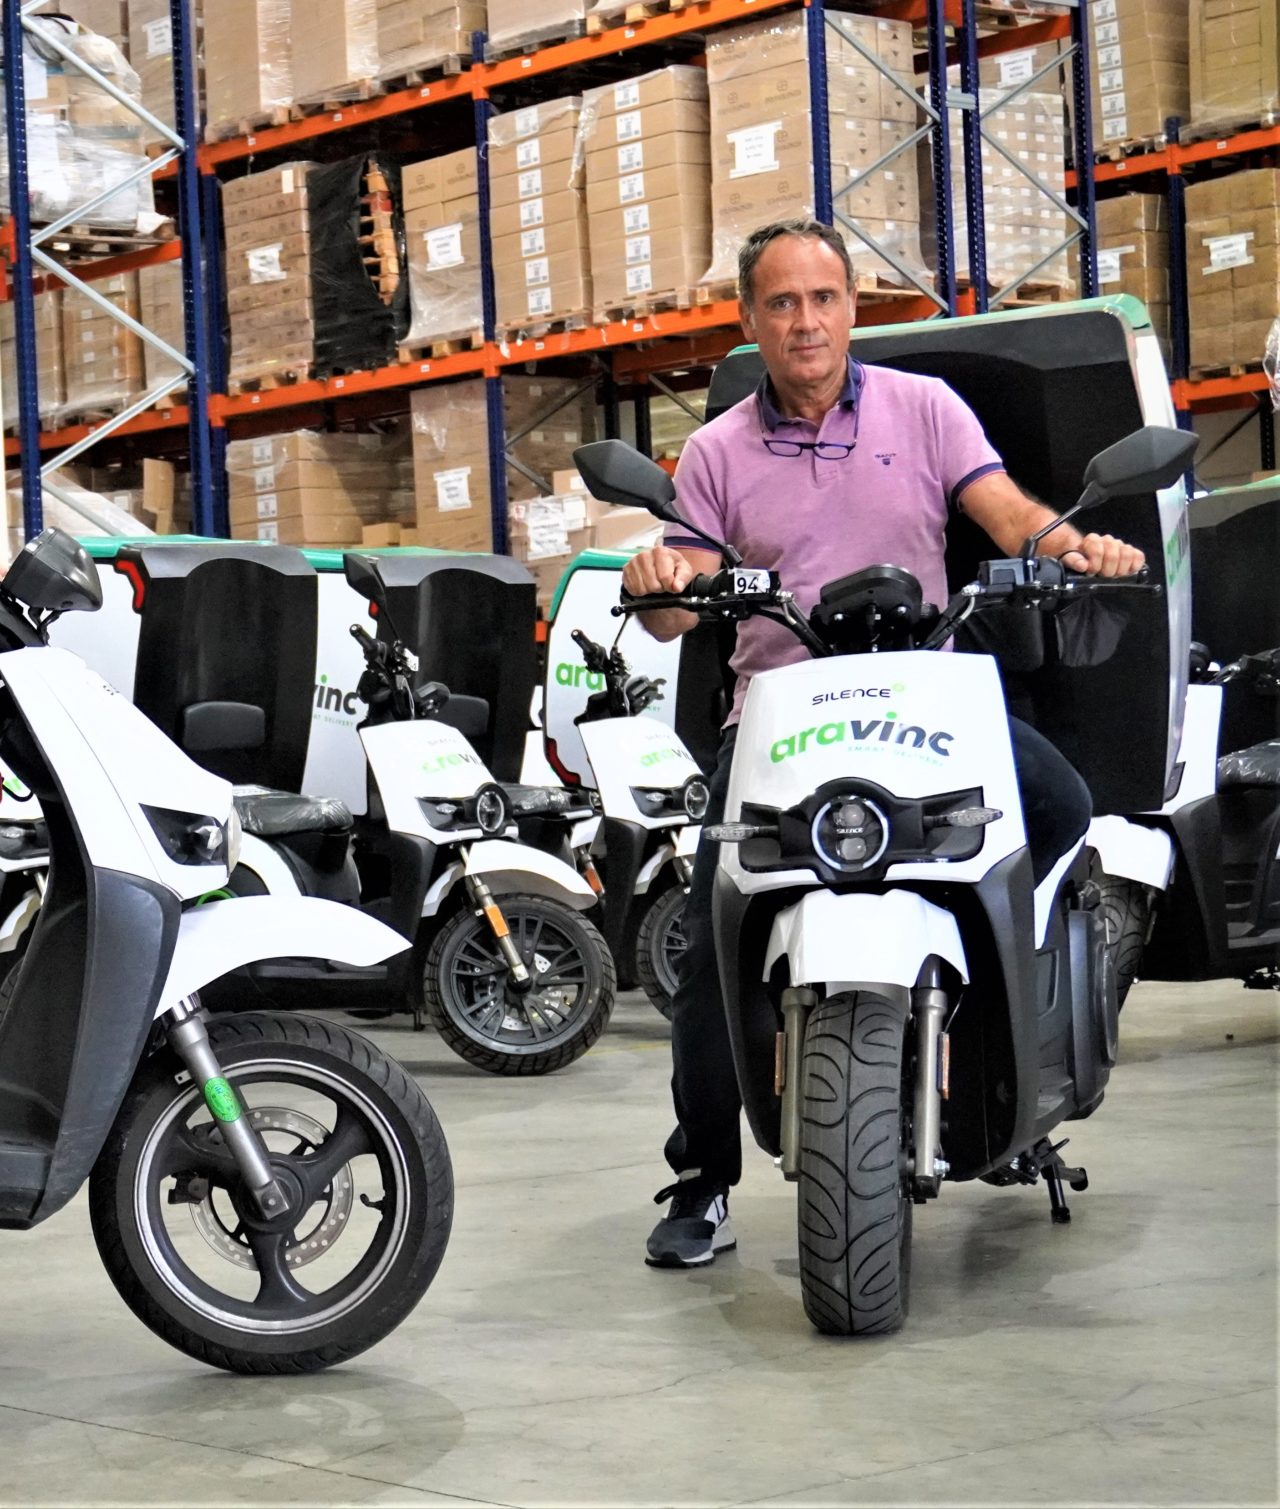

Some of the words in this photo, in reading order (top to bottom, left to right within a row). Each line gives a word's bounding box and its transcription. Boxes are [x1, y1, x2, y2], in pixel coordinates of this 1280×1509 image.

[736, 576, 758, 593] 94
[811, 688, 892, 706] SILENCE
[770, 711, 955, 763] aravinc
